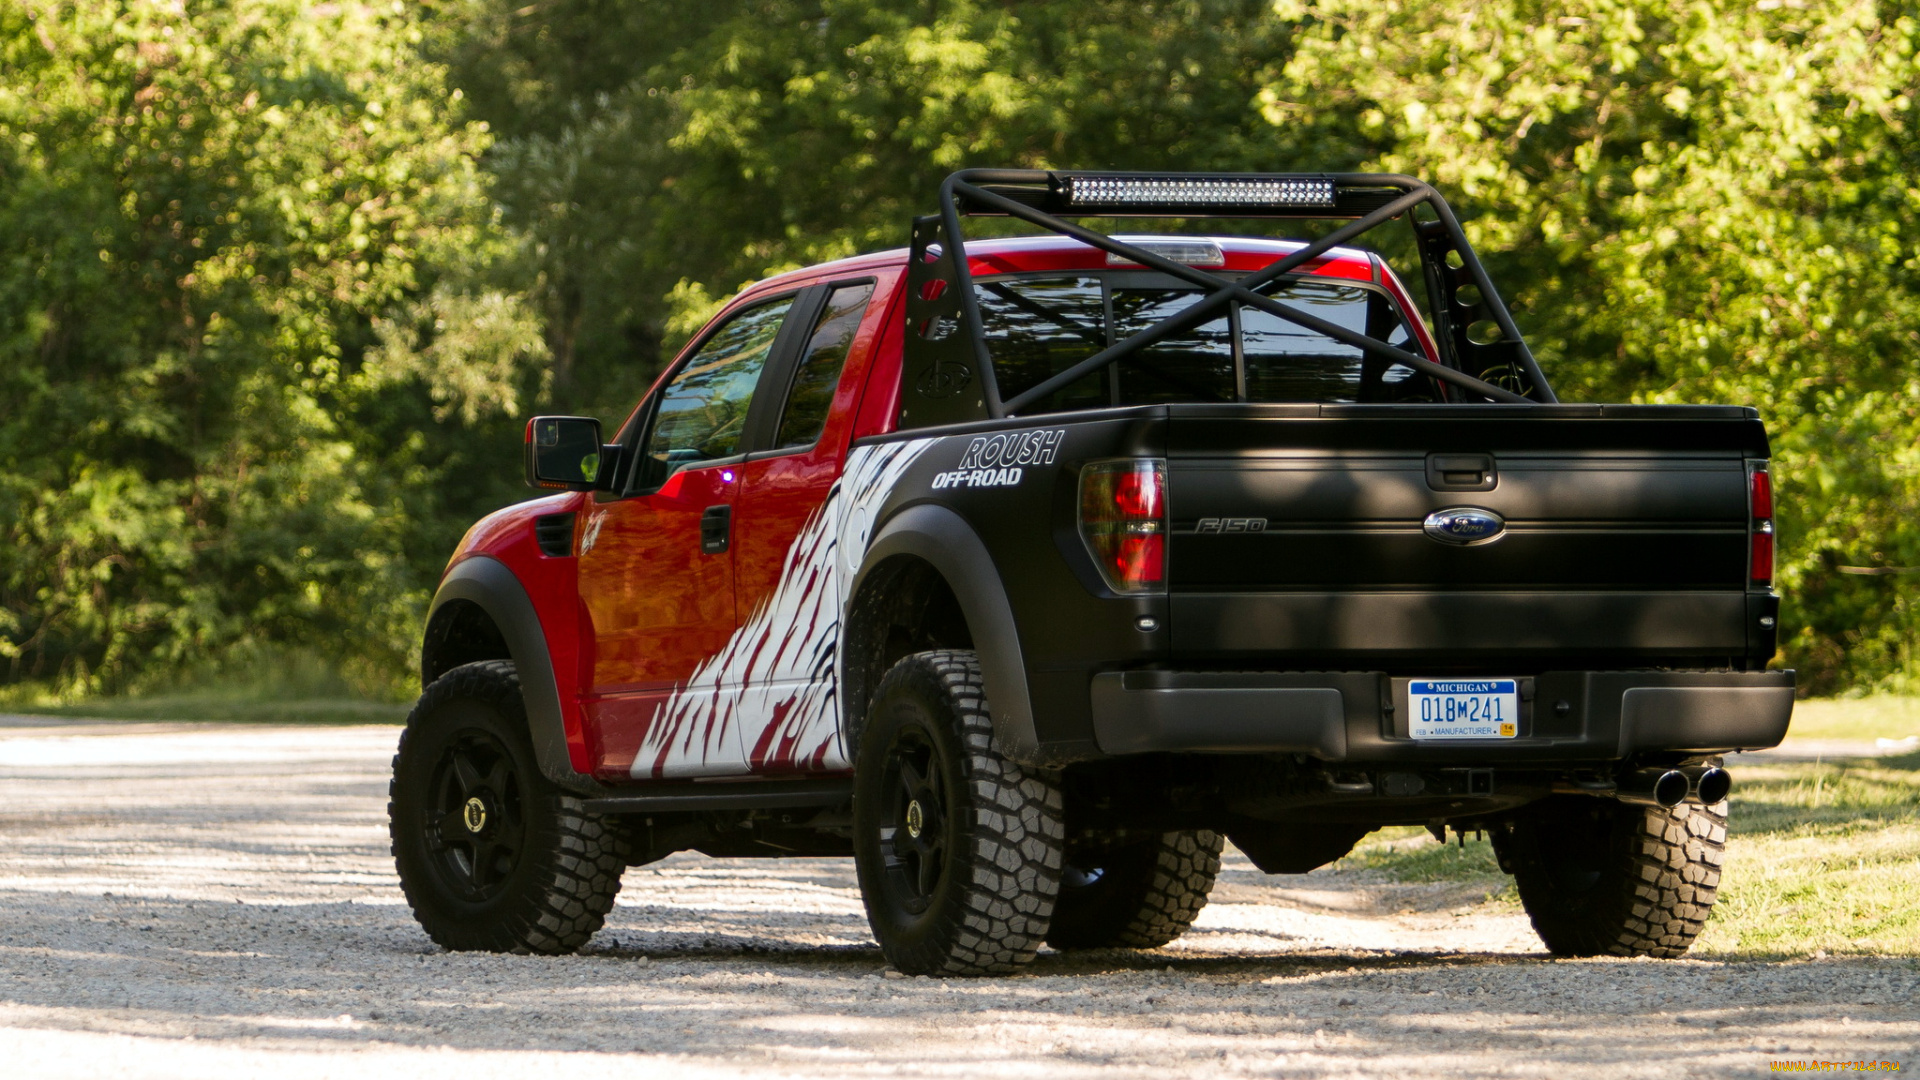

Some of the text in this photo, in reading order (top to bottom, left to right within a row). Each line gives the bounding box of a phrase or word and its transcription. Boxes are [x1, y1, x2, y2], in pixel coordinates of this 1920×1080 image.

[958, 430, 1065, 469] ROUSH
[931, 467, 1022, 489] OFF-ROAD
[1194, 518, 1268, 534] F-150
[1452, 519, 1487, 533] Ford
[1436, 683, 1489, 692] MICHIGAN
[1421, 697, 1504, 722] 018M241
[1435, 727, 1493, 735] MANUFACTURER
